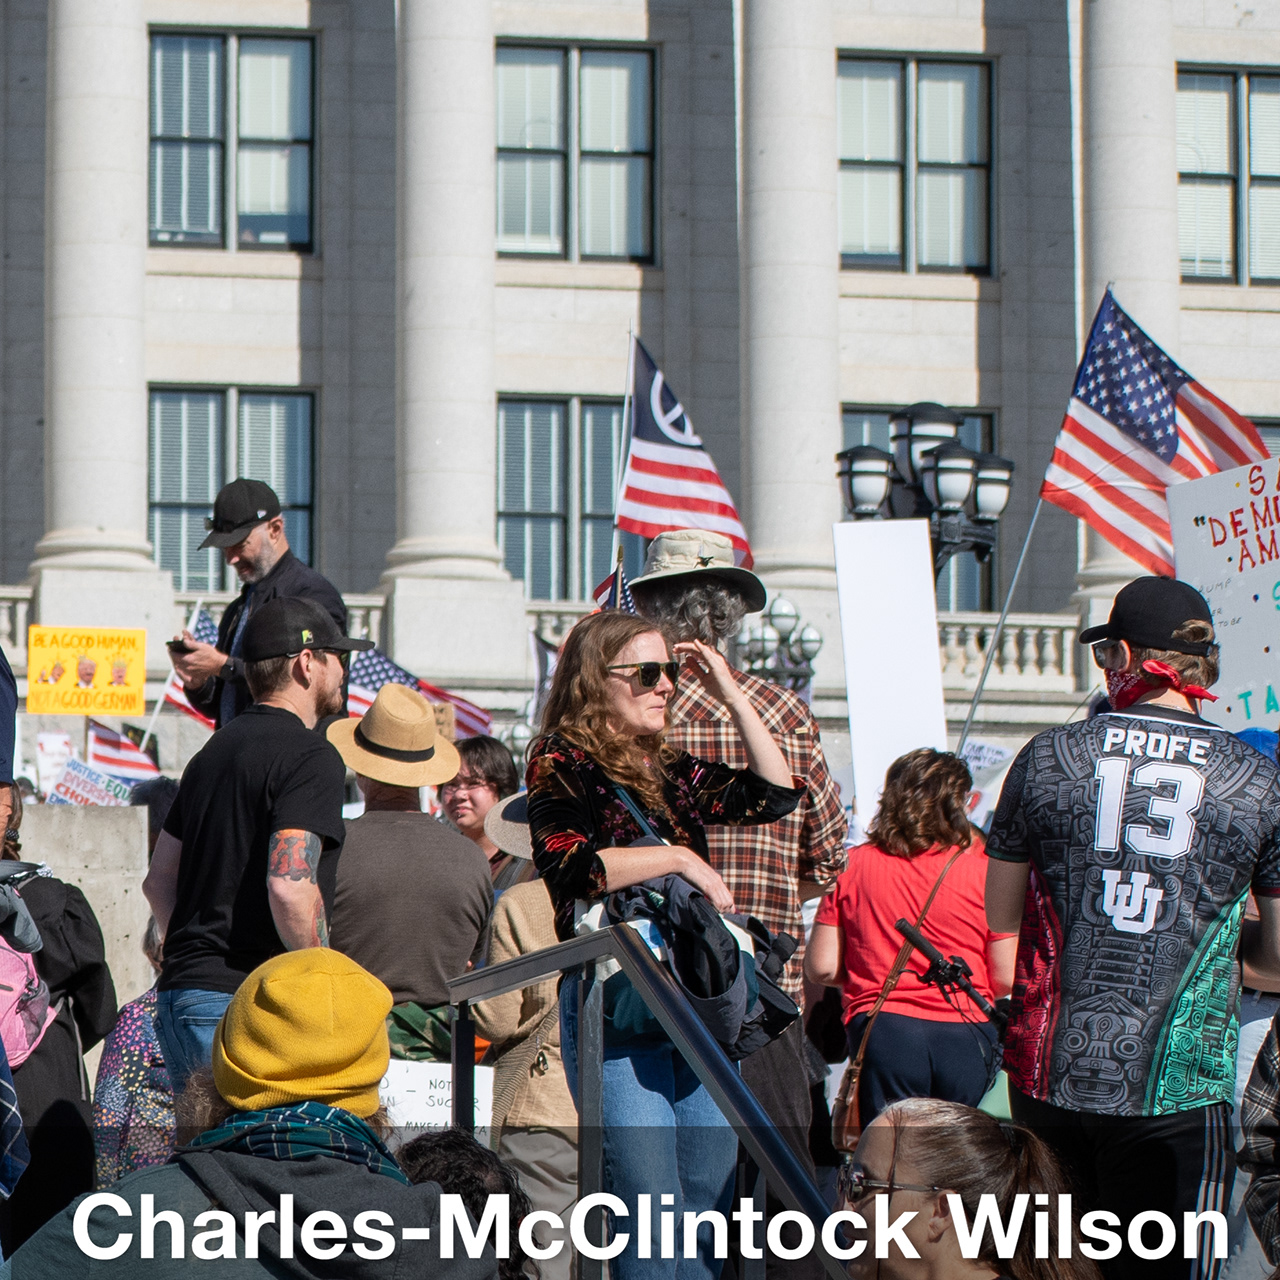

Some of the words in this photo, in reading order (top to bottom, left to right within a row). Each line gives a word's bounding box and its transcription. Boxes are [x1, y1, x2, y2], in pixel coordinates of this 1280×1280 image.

[61, 634, 95, 649] GOOD
[1102, 729, 1212, 765] PROFE
[66, 757, 103, 784] JUSTICE
[1095, 756, 1207, 861] 13
